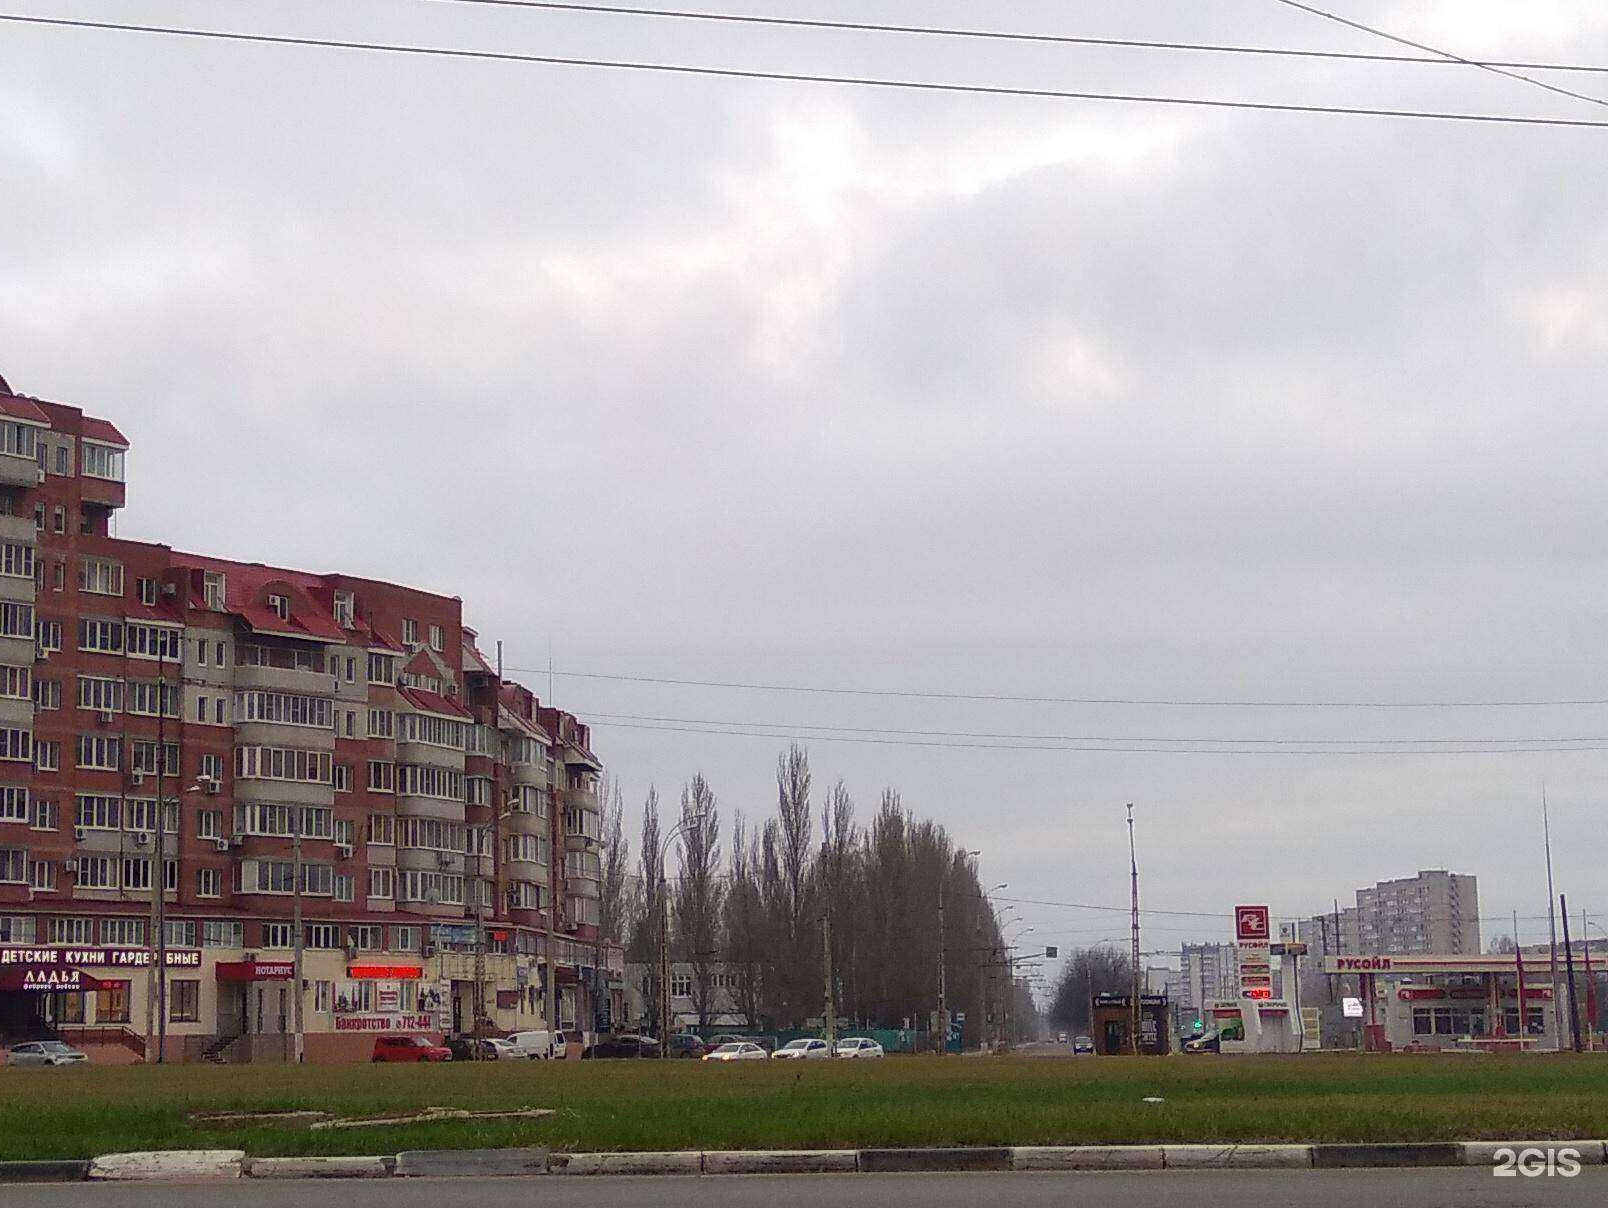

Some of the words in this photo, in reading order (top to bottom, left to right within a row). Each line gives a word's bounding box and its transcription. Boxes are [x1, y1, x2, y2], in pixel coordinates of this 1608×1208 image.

[1239, 941, 1268, 949] РУСОЙЛ
[1, 950, 58, 964] ДЕТСКИЕ
[66, 951, 105, 964] КУХНИ
[111, 951, 199, 966] ГАРДЕБНЫЕ
[1337, 956, 1391, 970] РУСОЙЛ
[24, 969, 80, 984] ЛАДЬЯ
[255, 966, 292, 975] НОТАРИУС
[335, 1016, 391, 1030] Банкротство
